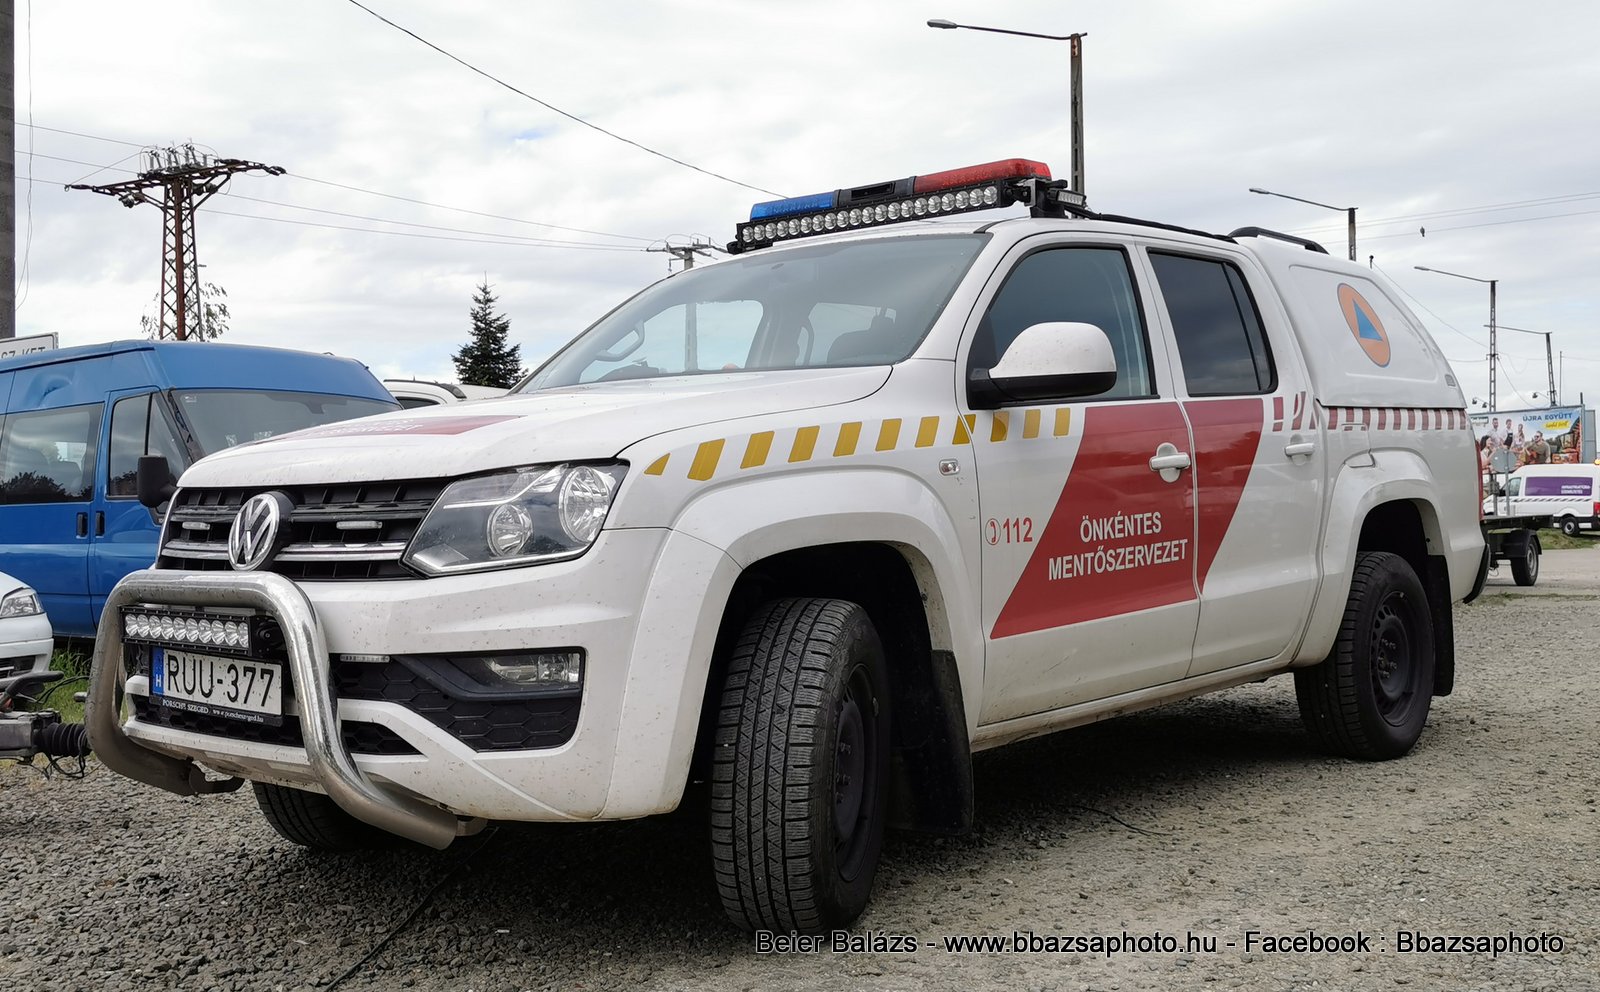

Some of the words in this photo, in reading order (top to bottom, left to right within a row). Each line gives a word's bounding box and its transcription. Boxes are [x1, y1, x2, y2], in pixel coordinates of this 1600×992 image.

[1544, 412, 1573, 420] EGYÜTT
[1002, 517, 1033, 544] 112
[1080, 510, 1162, 543] ÖNKÉNTES
[1048, 538, 1188, 581] MENTŐSZERVEZET
[155, 673, 162, 688] H
[167, 654, 275, 707] RUU-377
[187, 704, 209, 714] SZEGED
